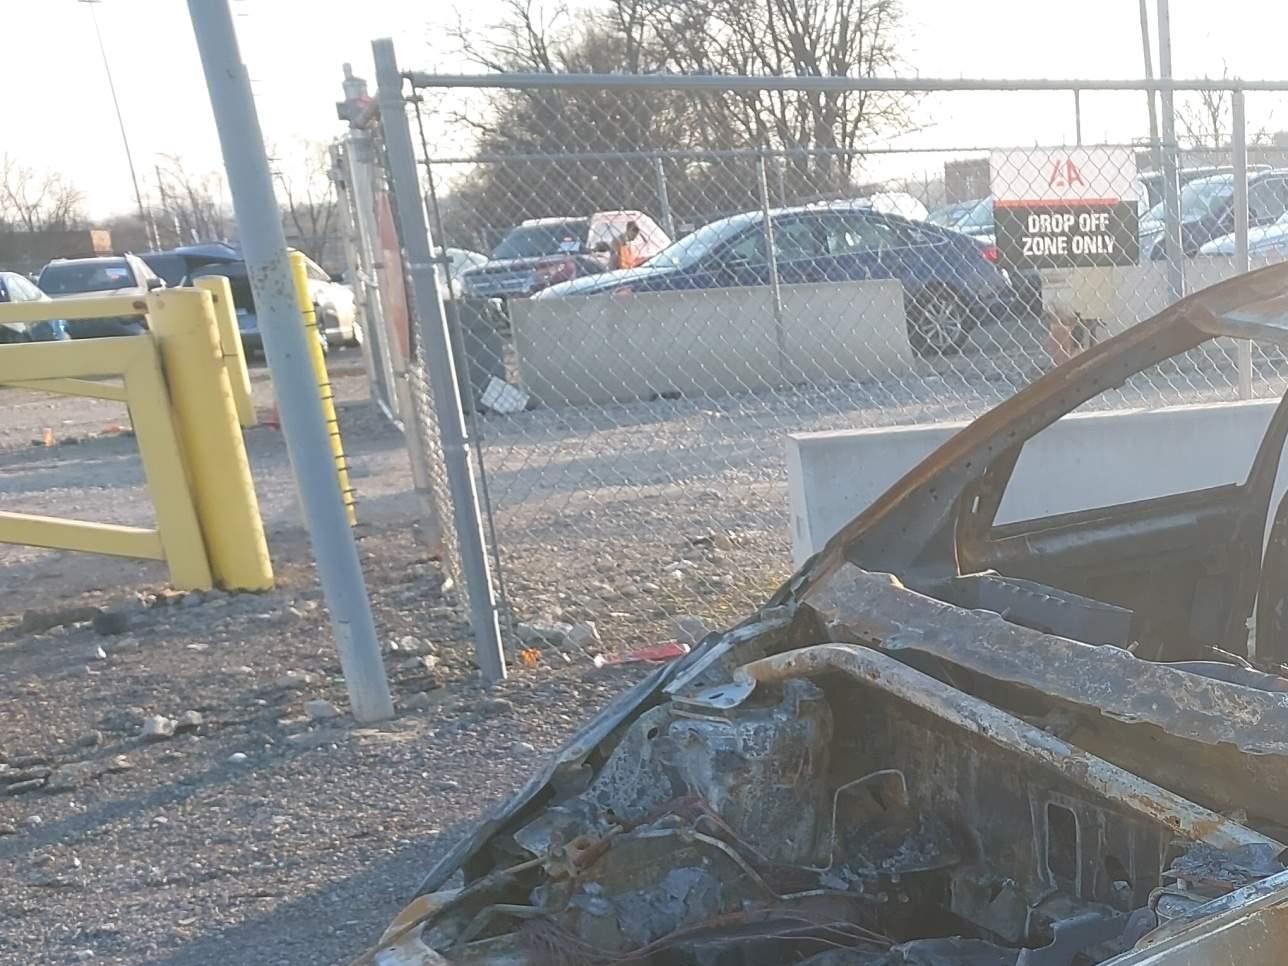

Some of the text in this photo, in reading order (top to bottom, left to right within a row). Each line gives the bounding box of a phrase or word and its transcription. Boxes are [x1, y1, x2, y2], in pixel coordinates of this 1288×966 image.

[1028, 213, 1109, 233] DROP OFF
[1022, 235, 1115, 256] ZONE ONLY
